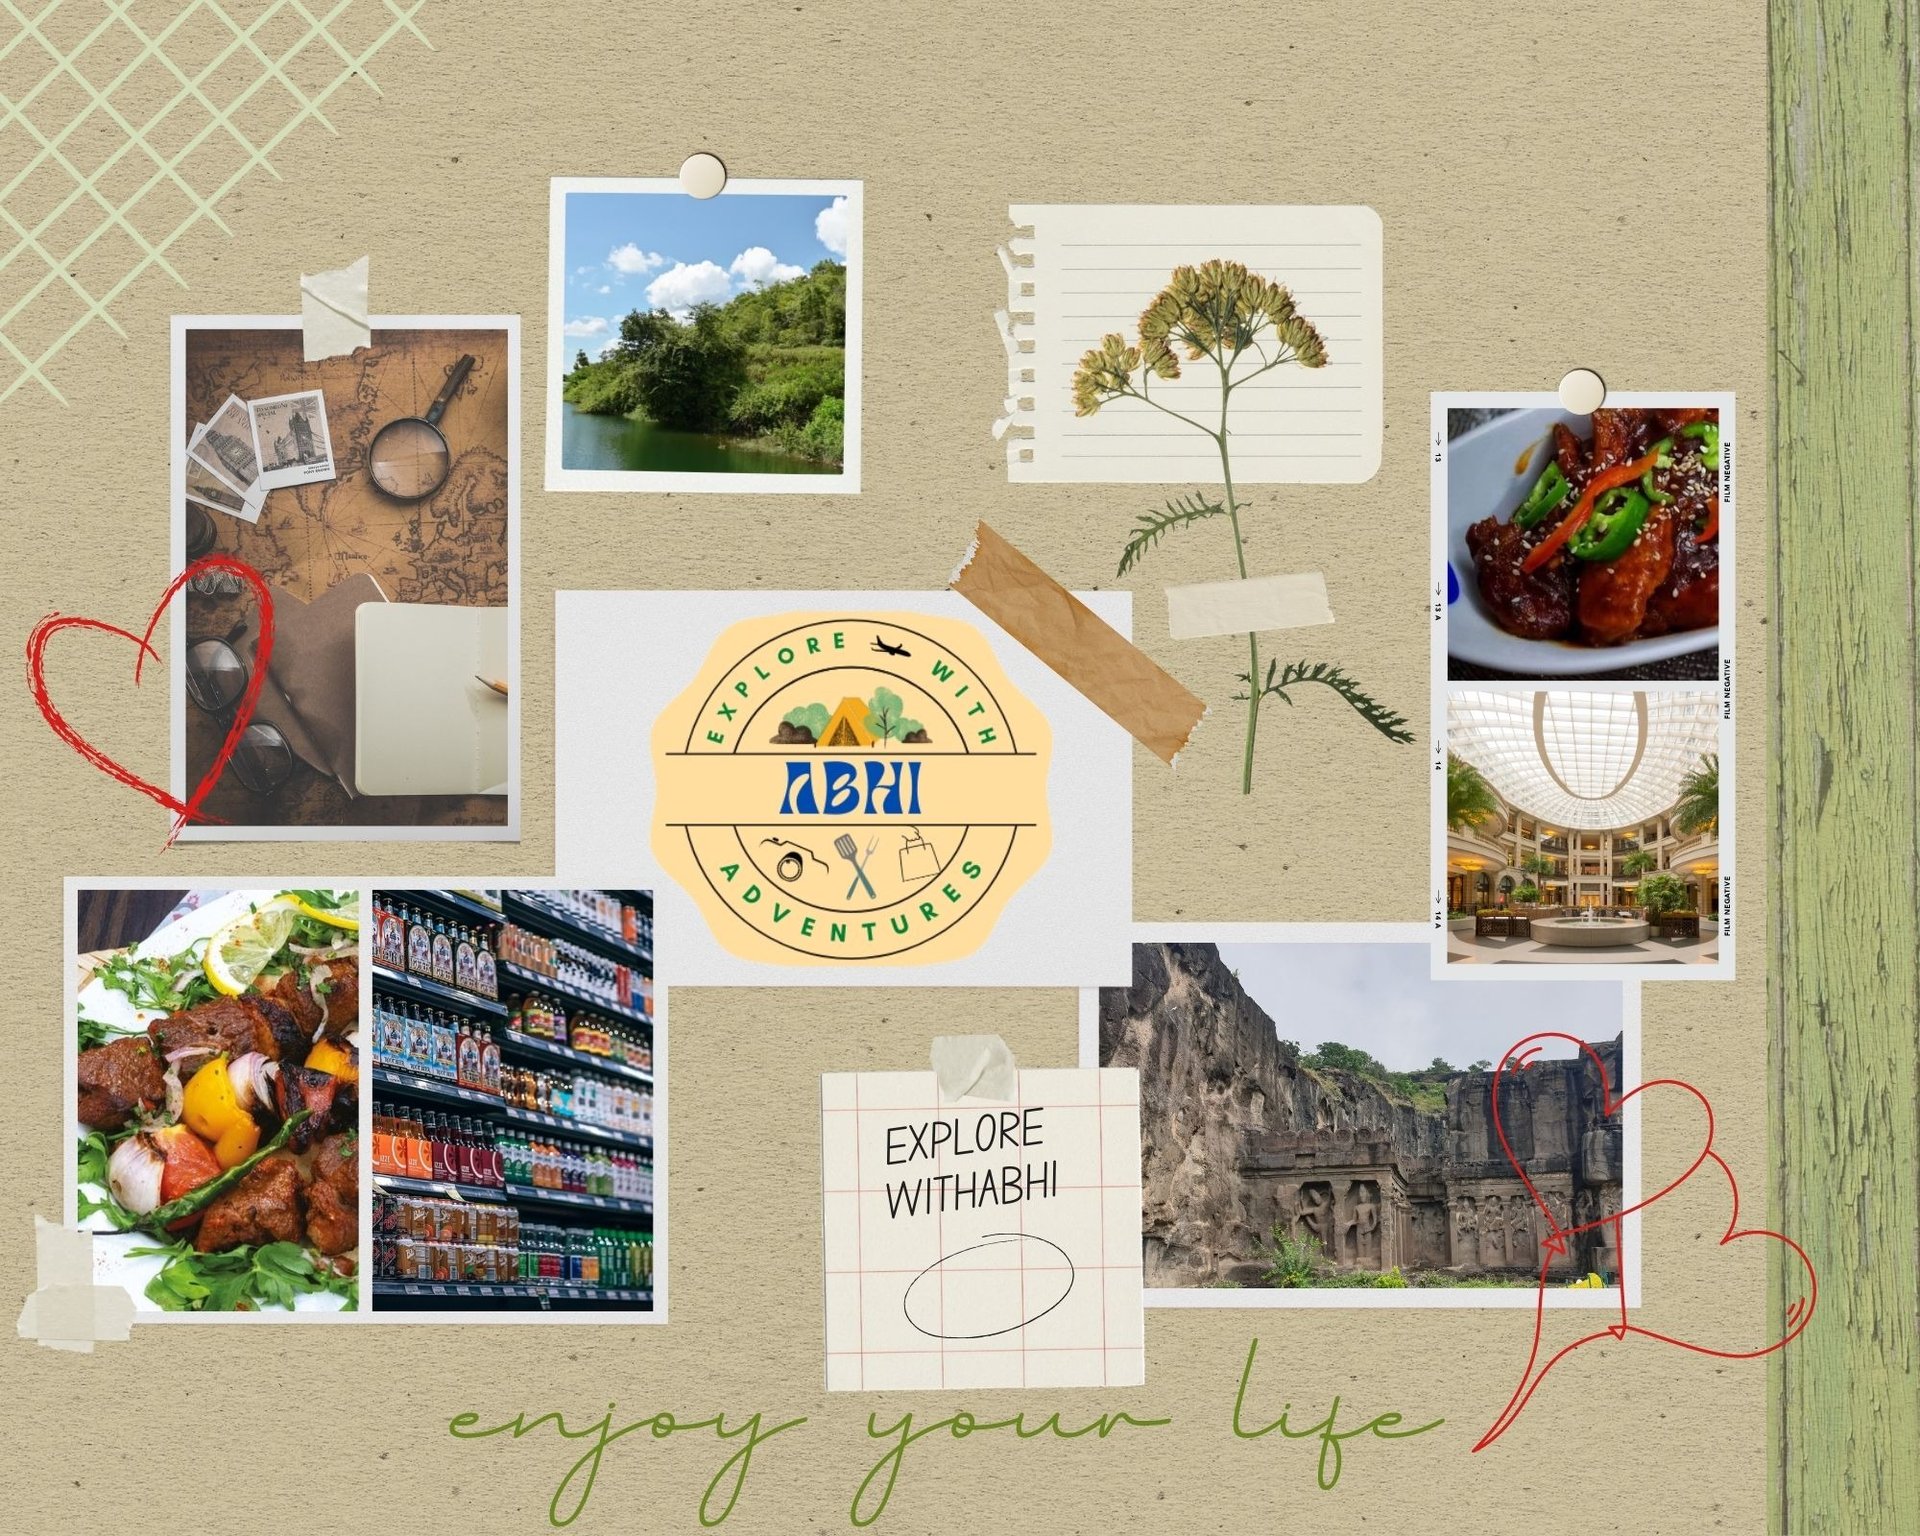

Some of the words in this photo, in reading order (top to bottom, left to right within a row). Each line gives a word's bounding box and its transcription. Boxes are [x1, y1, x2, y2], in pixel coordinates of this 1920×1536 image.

[1435, 453, 1441, 462] 13
[1435, 603, 1441, 613] 13
[707, 632, 845, 744] EXPLORE
[931, 660, 997, 744] WITH
[779, 761, 922, 815] ABHI
[1435, 761, 1441, 771] 14
[720, 860, 982, 943] ADVENTURES
[1435, 911, 1441, 920] 14
[886, 1107, 1044, 1165] EXPLORE
[886, 1160, 1057, 1219] WITHABHI
